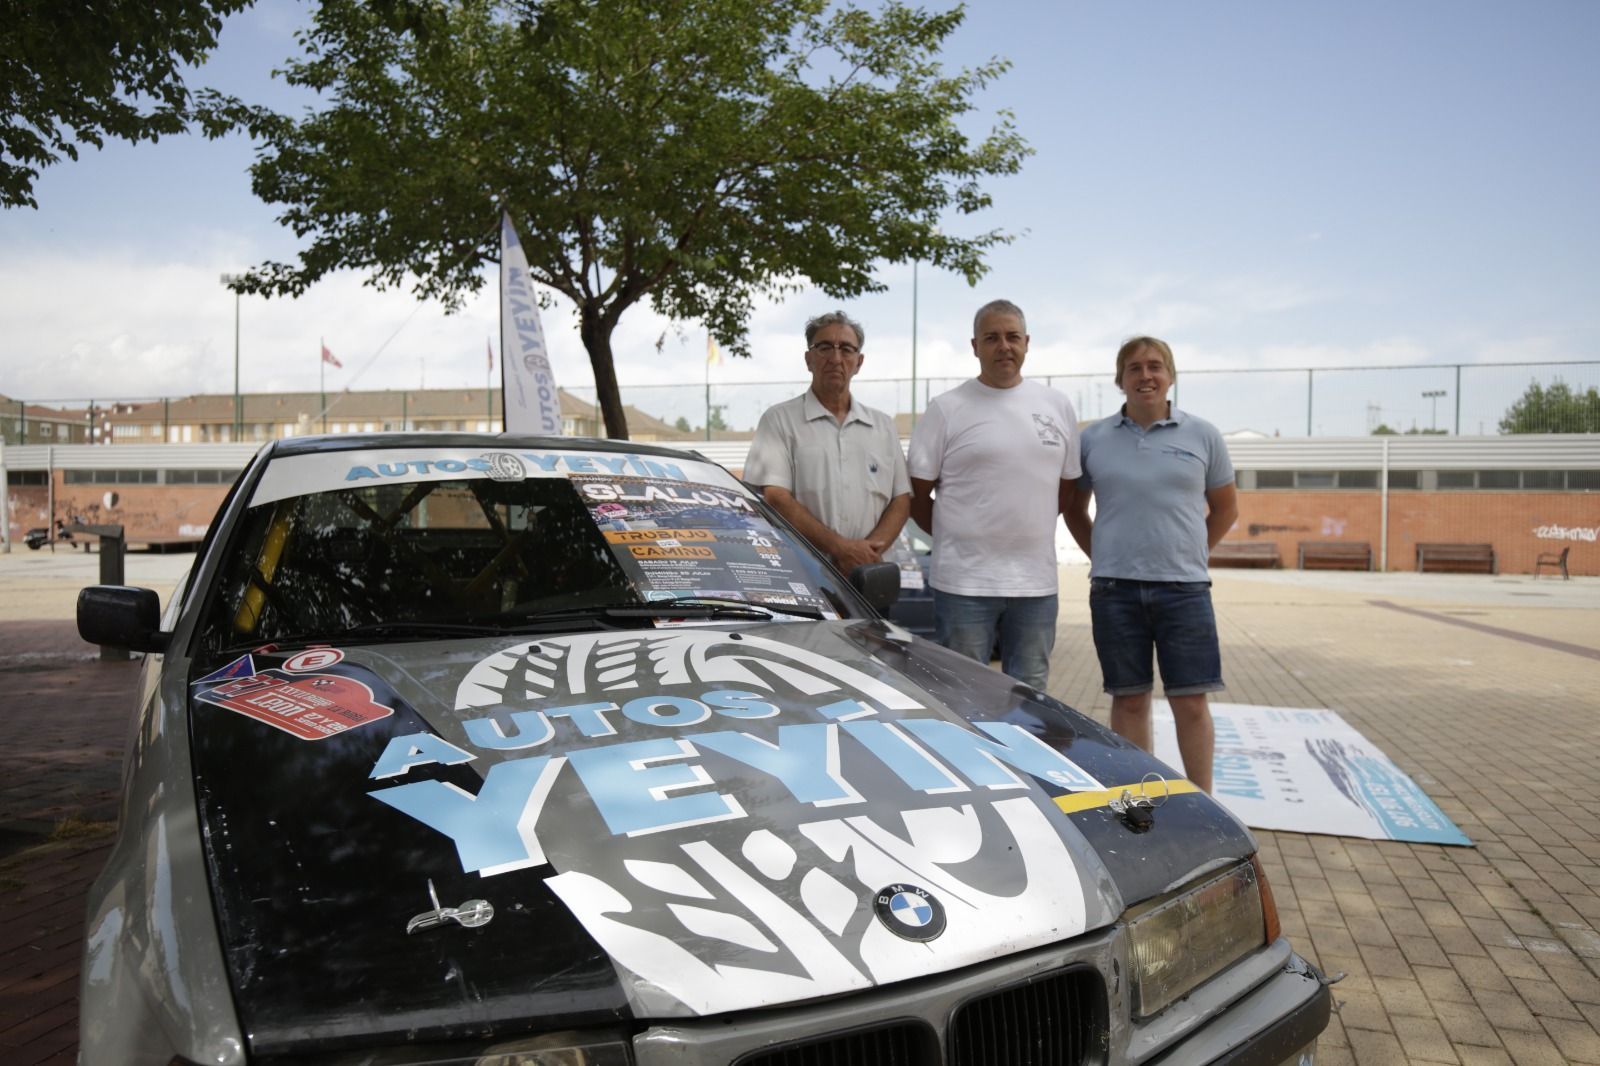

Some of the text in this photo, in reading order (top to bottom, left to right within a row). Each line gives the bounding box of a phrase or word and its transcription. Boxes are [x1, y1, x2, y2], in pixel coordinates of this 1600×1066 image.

[534, 372, 556, 433] UTOS
[345, 456, 491, 481] AUTOS
[582, 483, 753, 512] SLALOM
[614, 530, 708, 541] TROBAJO
[747, 536, 772, 547] 20
[632, 547, 711, 556] CAMINO
[301, 655, 326, 666] E
[368, 689, 782, 779] AUTOS
[1046, 770, 1087, 784] SL
[878, 885, 930, 905] BMW
